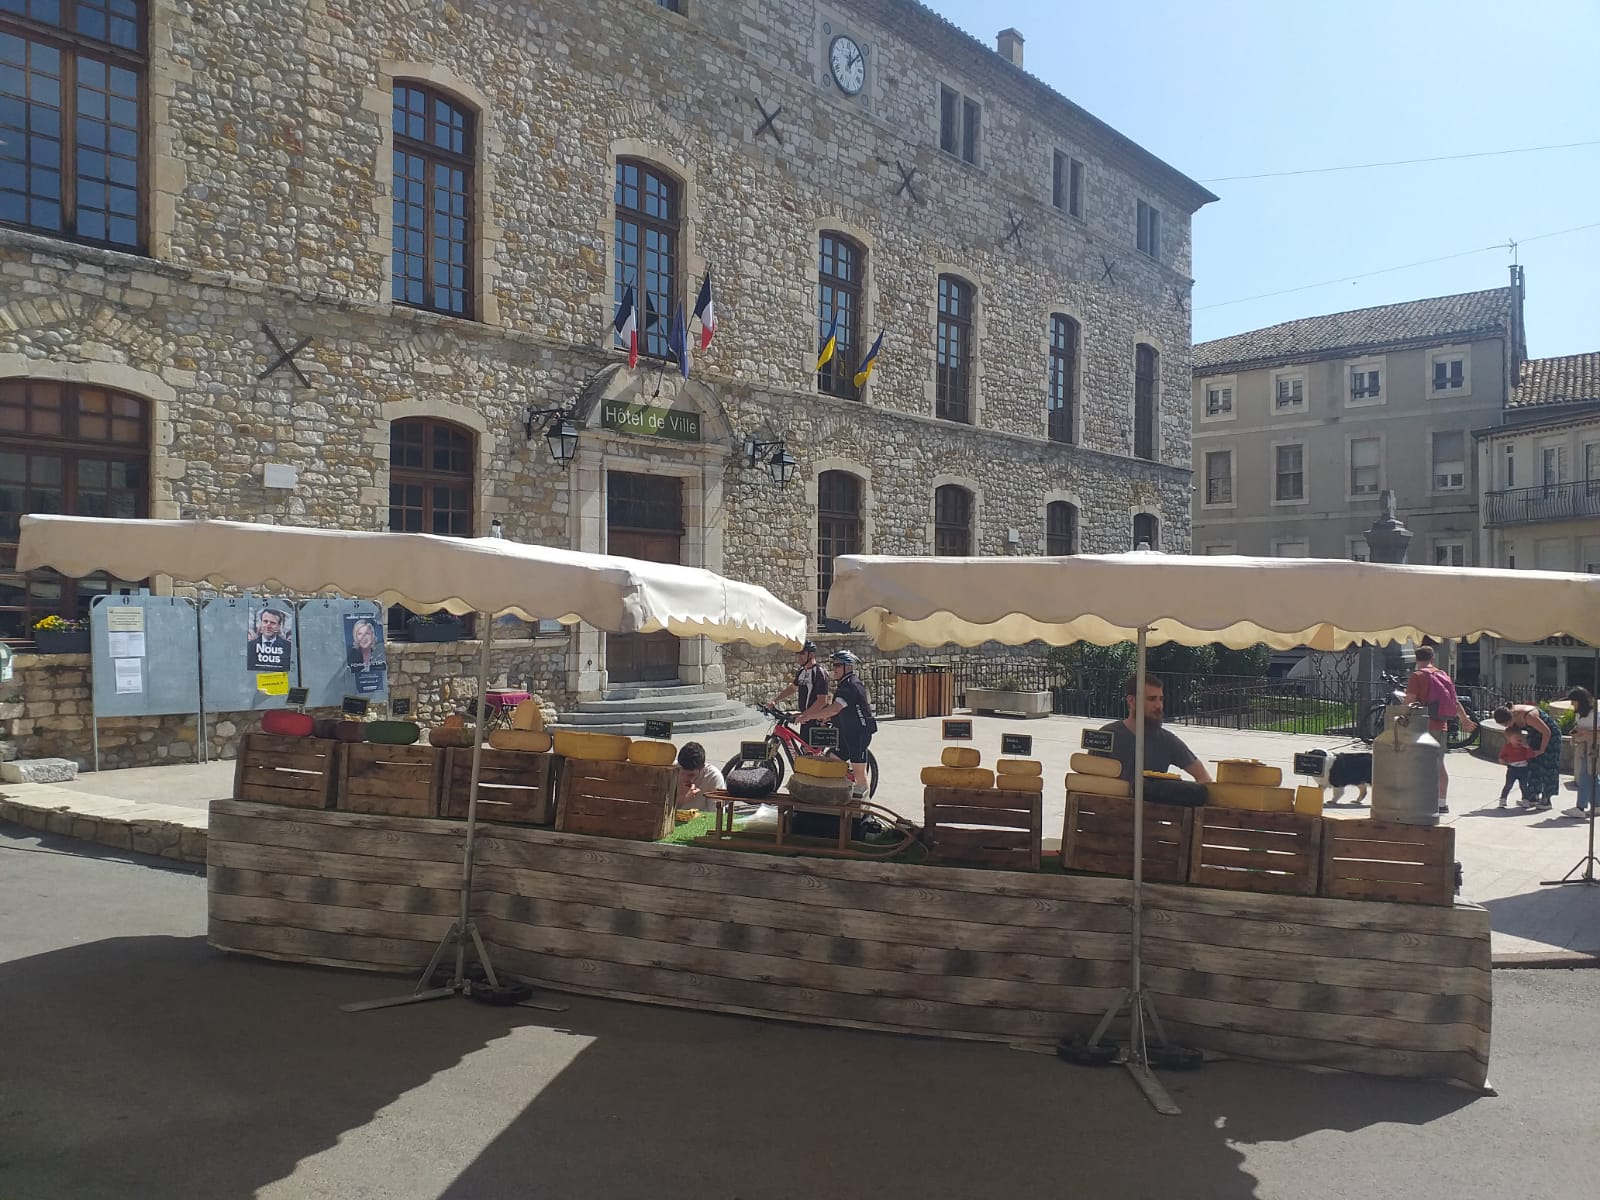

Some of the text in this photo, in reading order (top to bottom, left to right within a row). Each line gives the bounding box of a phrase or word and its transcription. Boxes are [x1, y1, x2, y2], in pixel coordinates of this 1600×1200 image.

[605, 406, 697, 434] Hôtel de Ville
[255, 642, 284, 655] Nous
[257, 653, 281, 663] tous
